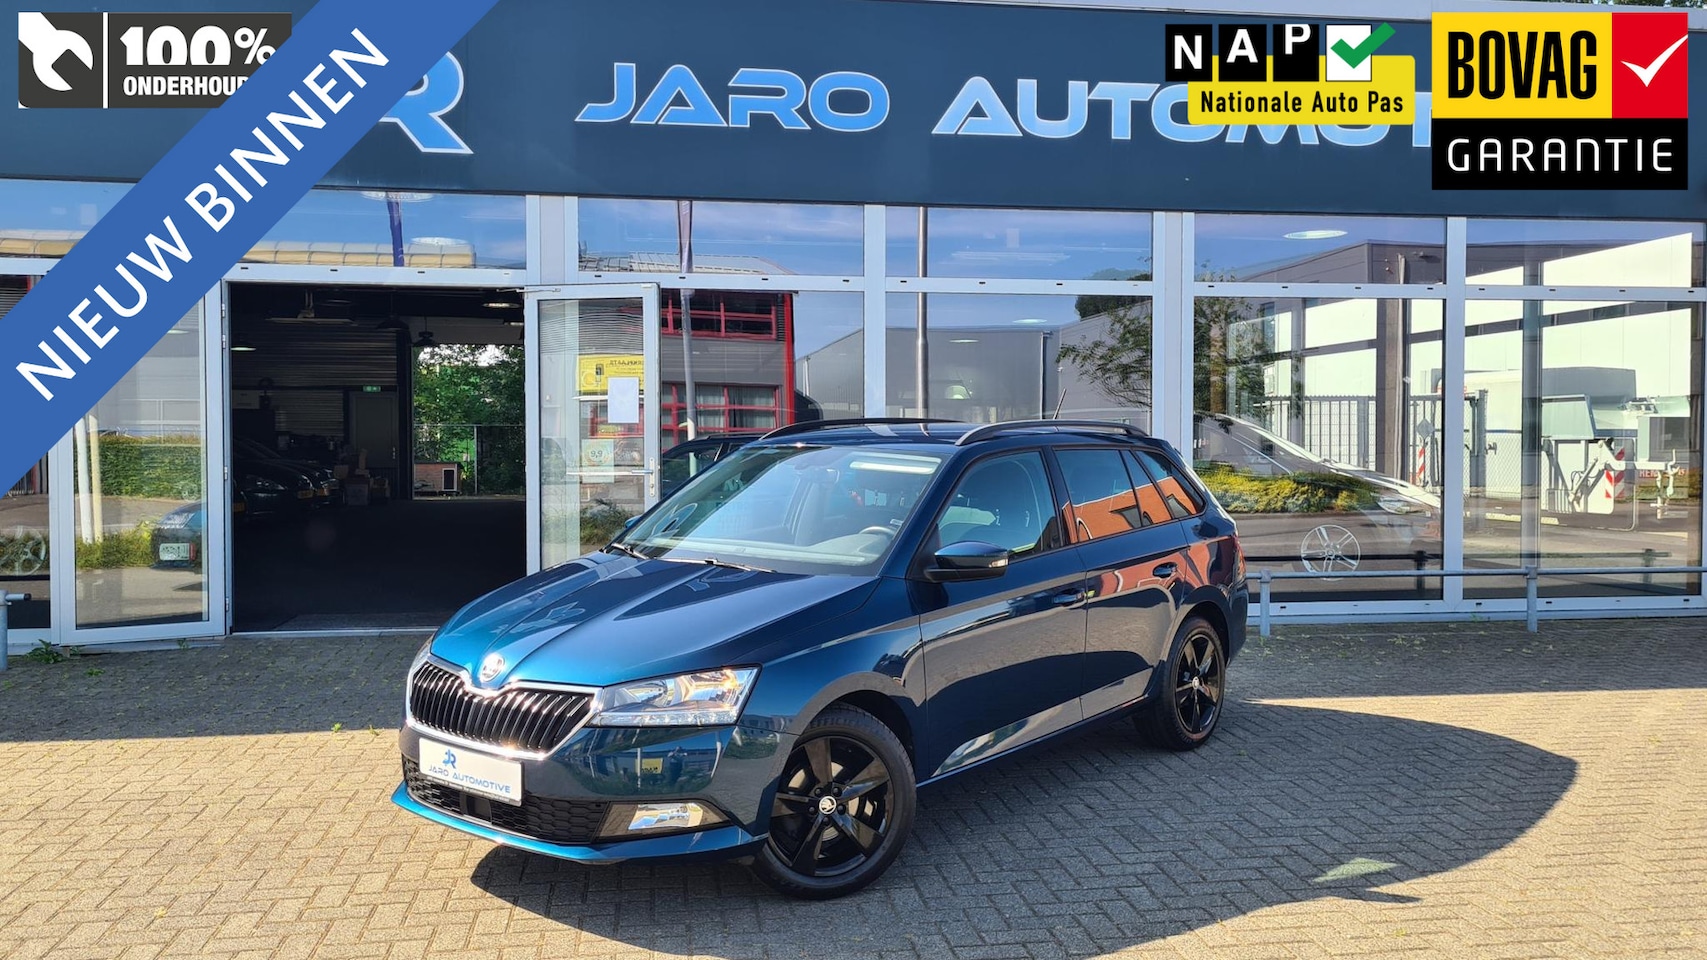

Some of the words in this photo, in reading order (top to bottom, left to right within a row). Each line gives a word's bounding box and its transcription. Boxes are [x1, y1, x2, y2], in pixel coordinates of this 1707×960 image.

[574, 62, 890, 132] JARO
[429, 766, 449, 777] JARO
[453, 773, 511, 793] AUTOMOTIVE
